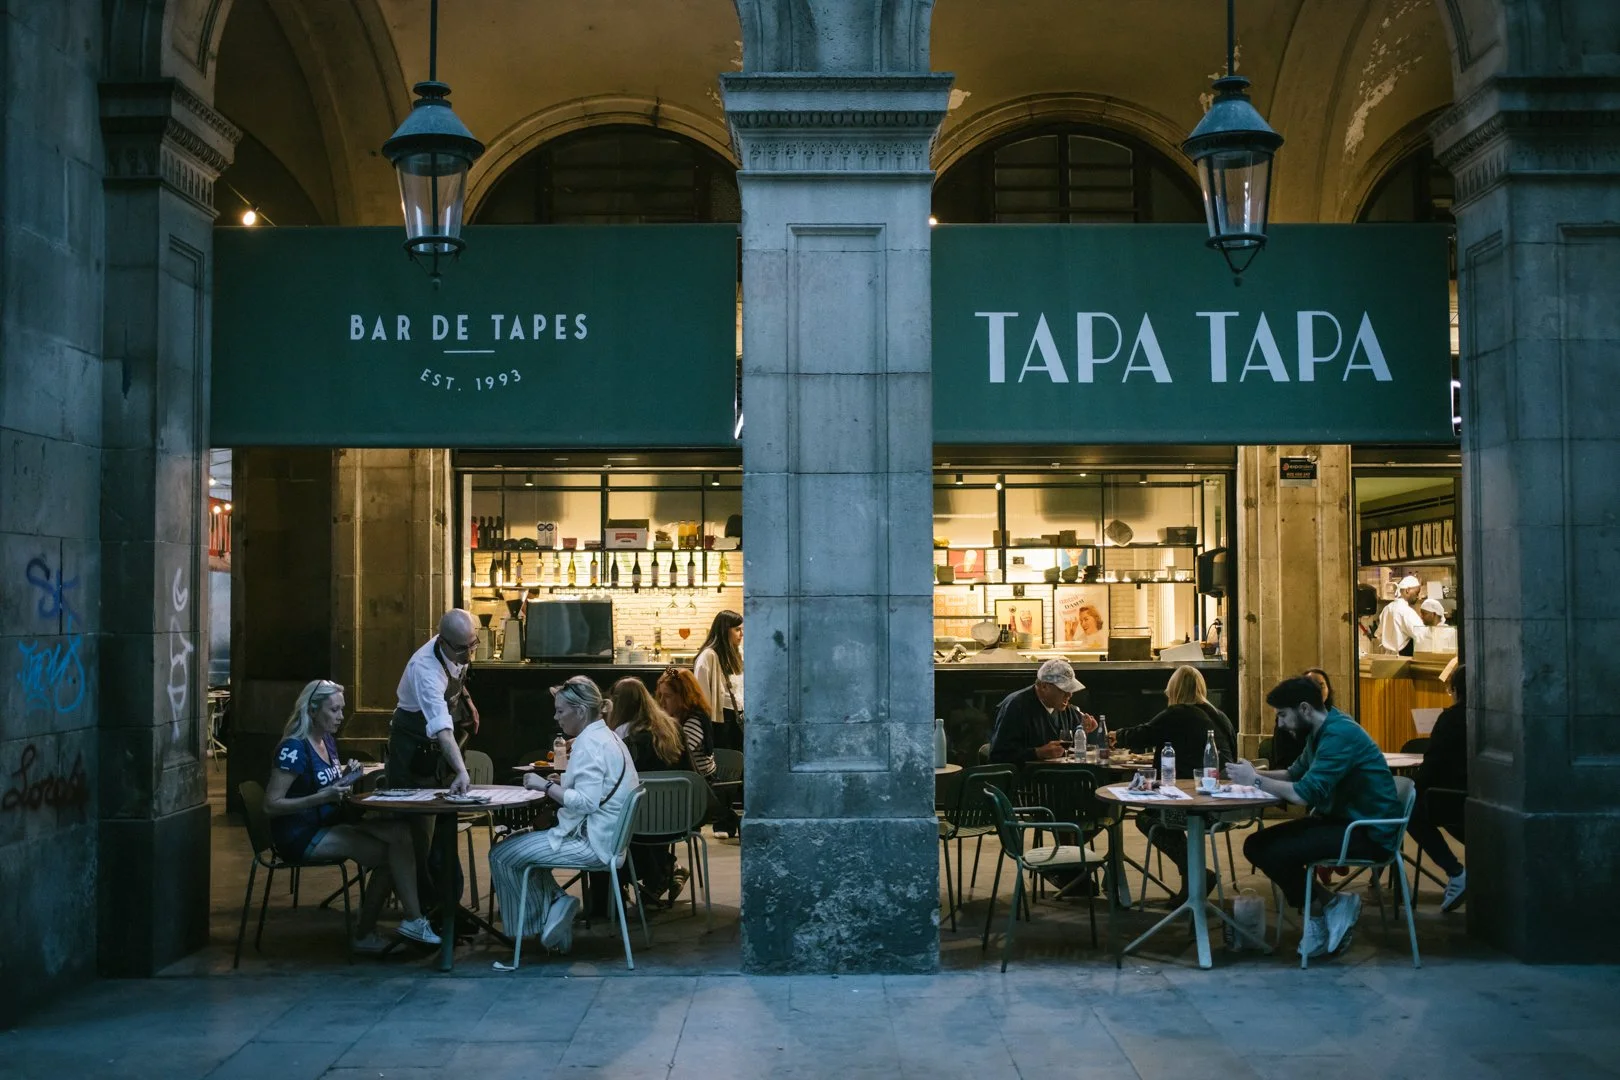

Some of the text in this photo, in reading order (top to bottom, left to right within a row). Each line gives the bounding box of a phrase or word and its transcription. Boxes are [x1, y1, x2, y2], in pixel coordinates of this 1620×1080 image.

[350, 313, 588, 341] BAR DE TAPES
[974, 310, 1394, 383] TAPA TAPA
[420, 368, 521, 392] EST. 1993
[279, 747, 298, 764] 54
